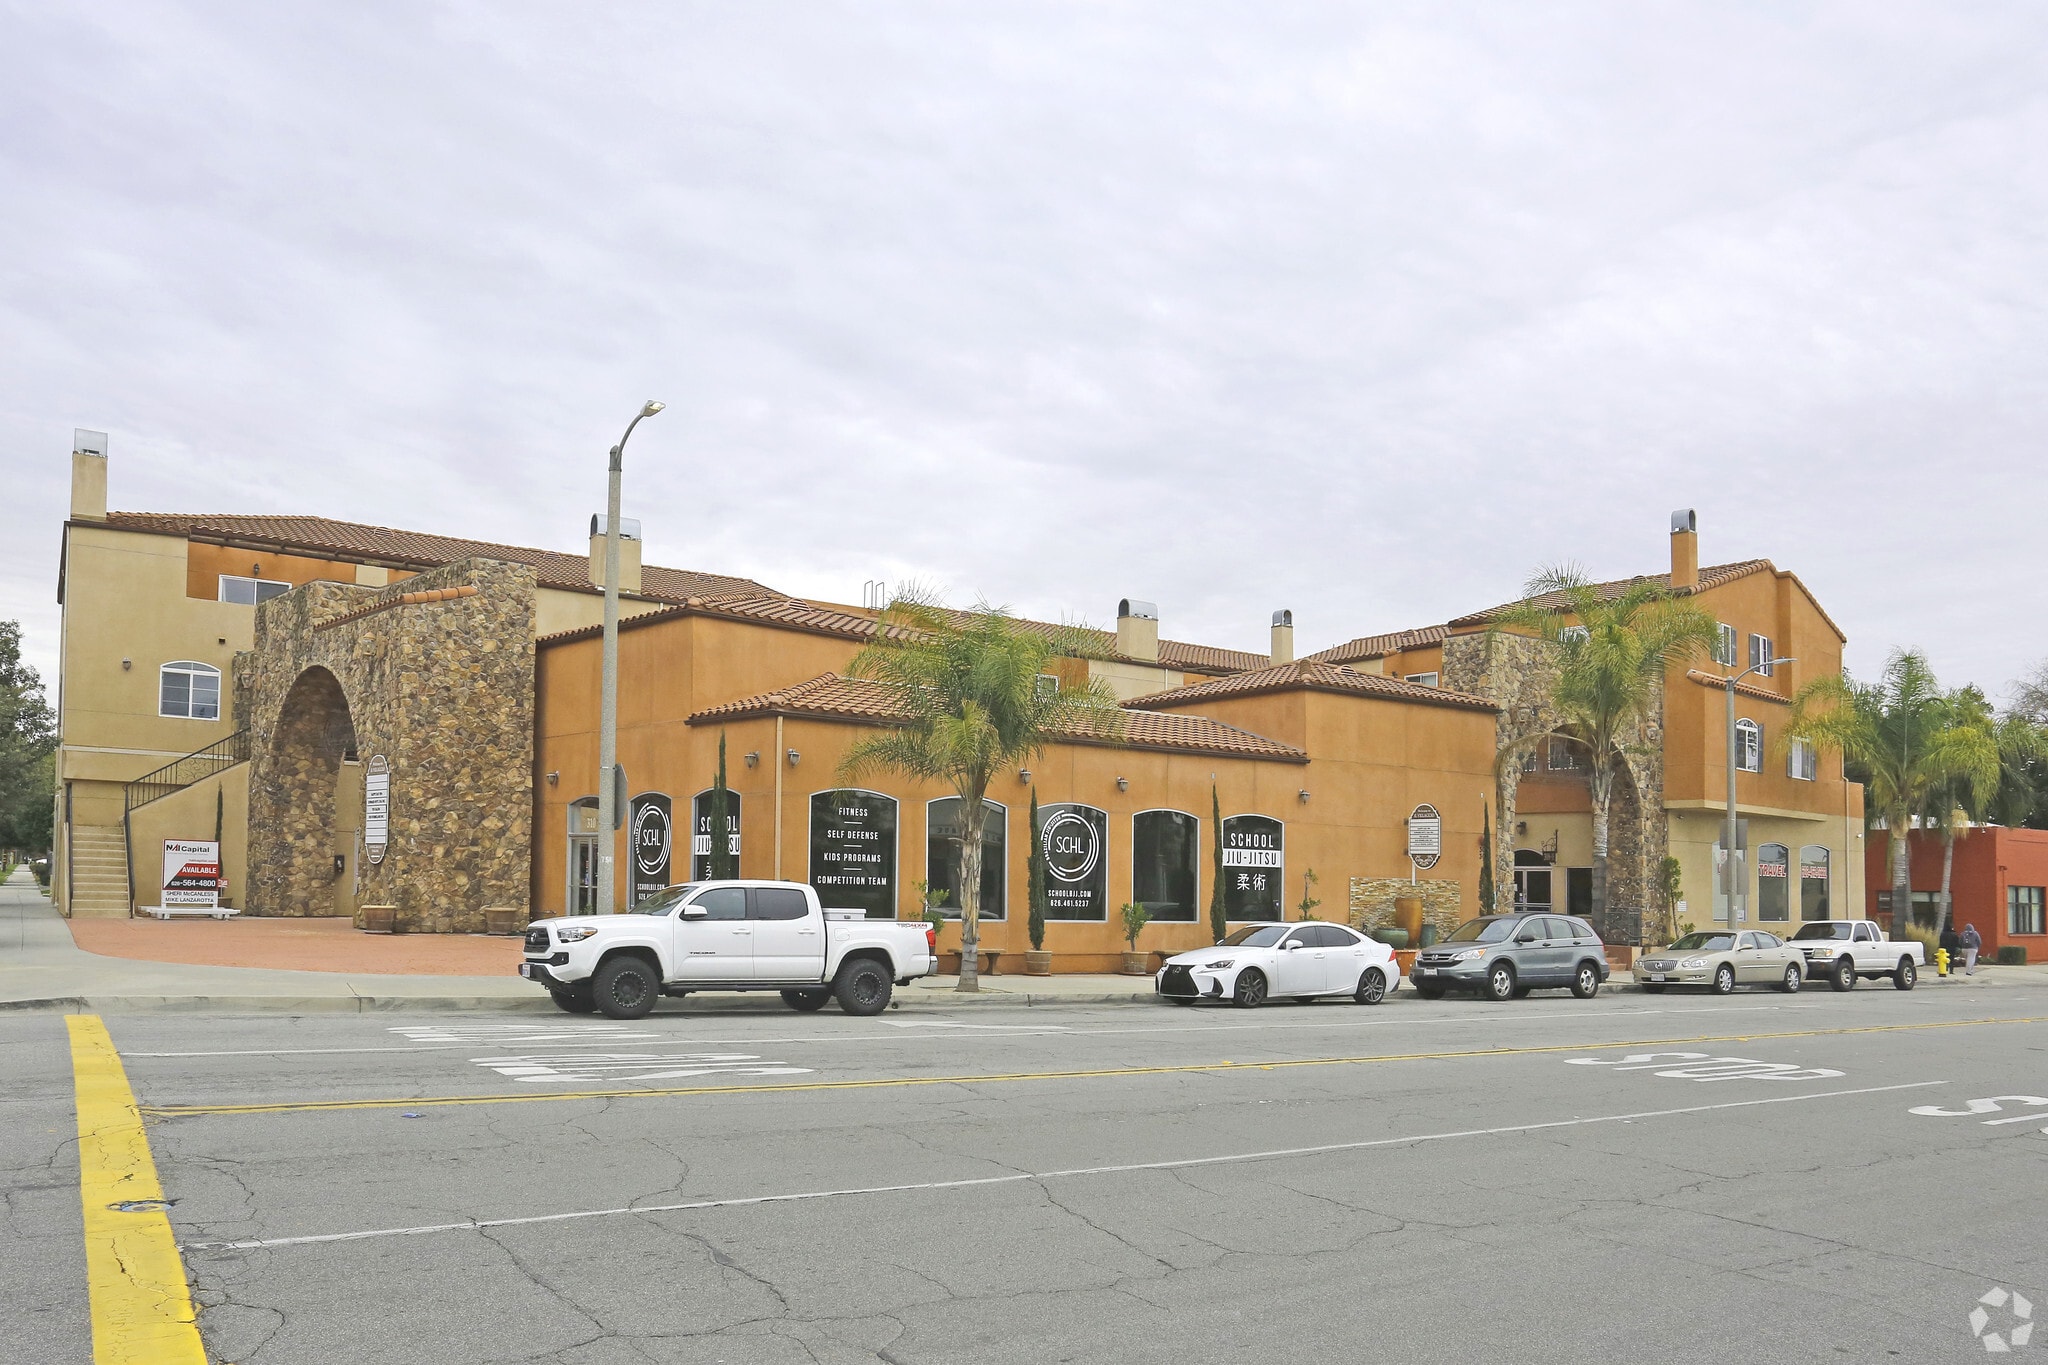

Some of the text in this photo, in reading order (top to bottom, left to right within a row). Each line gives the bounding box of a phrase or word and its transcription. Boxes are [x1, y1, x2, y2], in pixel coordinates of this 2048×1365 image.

[838, 807, 868, 817] FITNESS
[700, 815, 738, 832] SCOL
[642, 829, 661, 847] SCHL
[827, 829, 879, 840] SELF DEFENSE
[1230, 832, 1274, 848] SCHOOL
[166, 843, 210, 853] NAI Capital
[697, 836, 740, 853] JIUSU
[1055, 836, 1085, 854] SCHL
[823, 852, 882, 863] KIDS PROGRAMS
[1226, 851, 1277, 865] JIU-JITSU
[181, 866, 217, 874] AVAILABLE
[1759, 863, 1787, 877] TRAVEL
[817, 875, 887, 886] COMPETITION TEAM
[1237, 873, 1266, 891] 柔術
[1047, 889, 1092, 898] SCHOOLBJJ.COM
[467, 1052, 815, 1083] STOP
[1563, 1052, 1846, 1082] STOP
